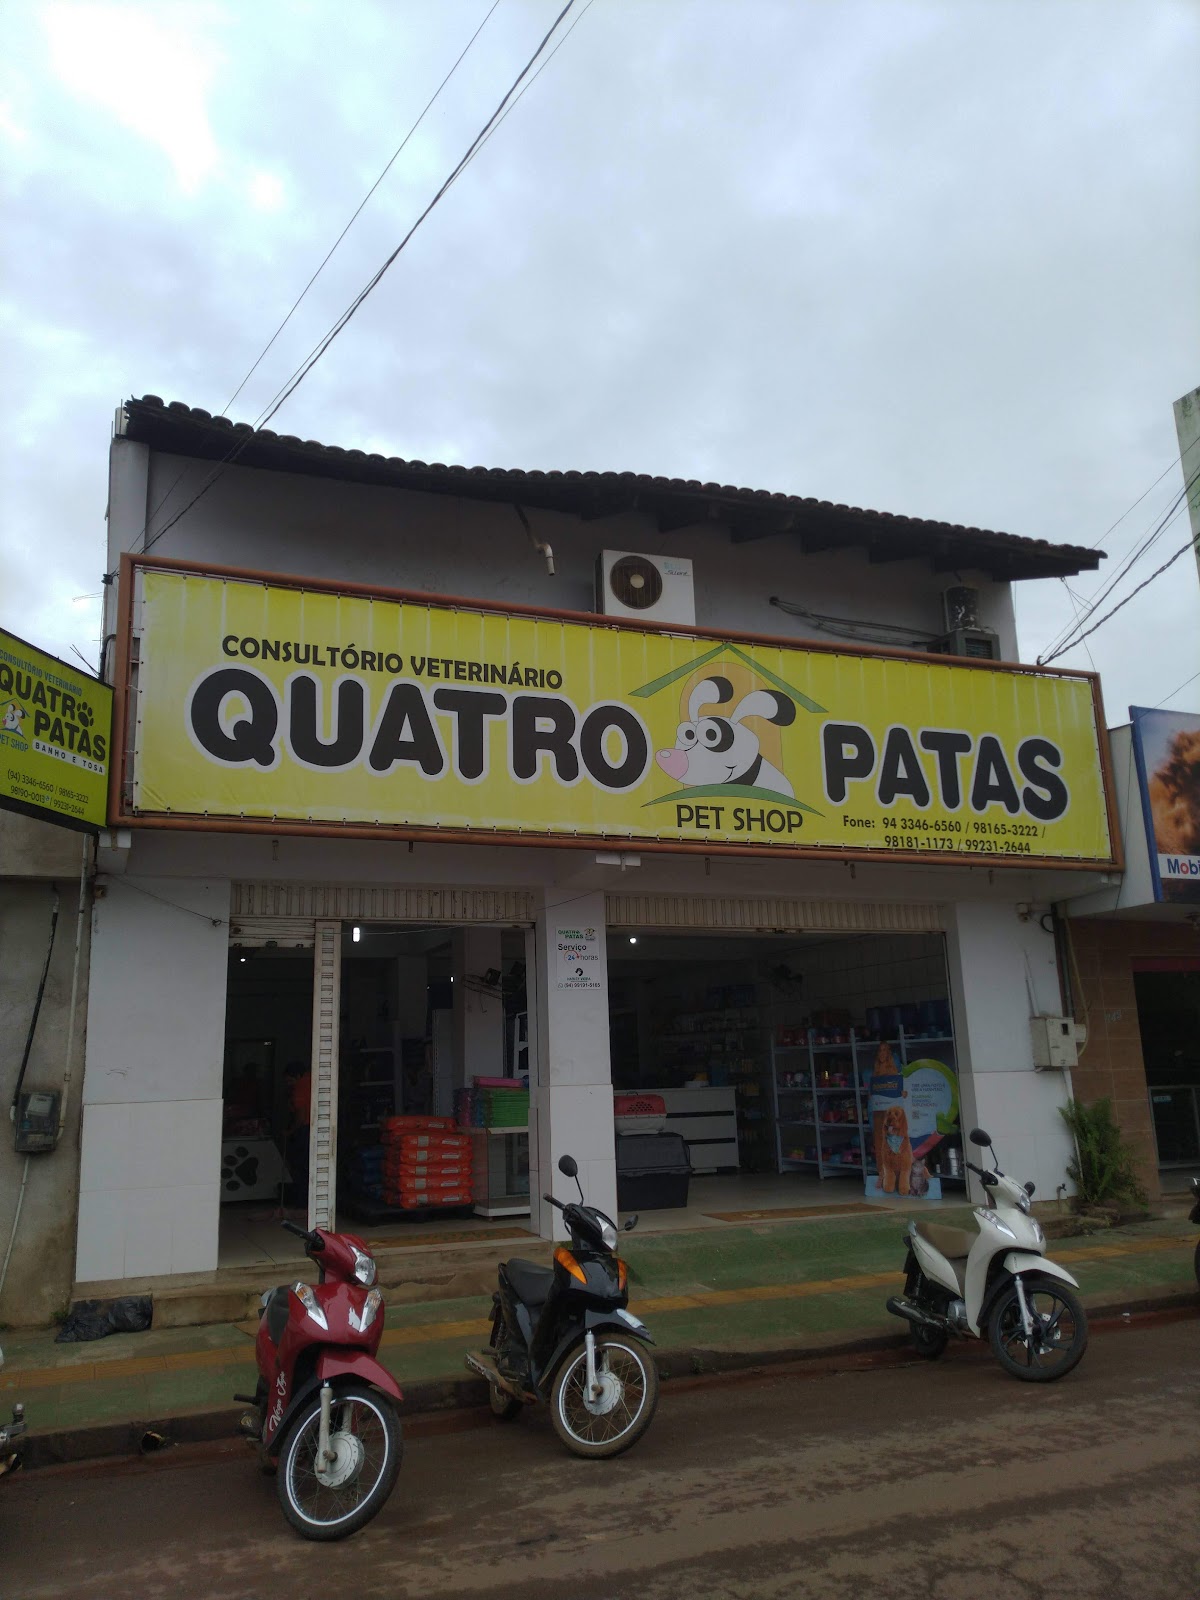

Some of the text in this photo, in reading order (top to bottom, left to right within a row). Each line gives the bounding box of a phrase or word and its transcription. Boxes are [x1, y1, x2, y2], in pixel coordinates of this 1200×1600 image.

[222, 634, 563, 690] CONSULTÓRIO VETERINÁRIO
[10, 738, 28, 753] SHOP
[33, 709, 106, 762] PATAS
[190, 666, 1068, 821] QUATRO PATAS
[35, 742, 103, 773] BANHO E TOSA
[7, 769, 20, 783] (94)
[676, 804, 804, 834] PET SHOP
[843, 815, 875, 829] Fone:
[882, 817, 897, 829] 94
[900, 818, 962, 833] 3346-6560
[973, 822, 1038, 837] 98165-3222
[884, 835, 954, 850] 98181-1173
[965, 838, 1031, 853] 99231-2644
[558, 944, 587, 952] Serviço
